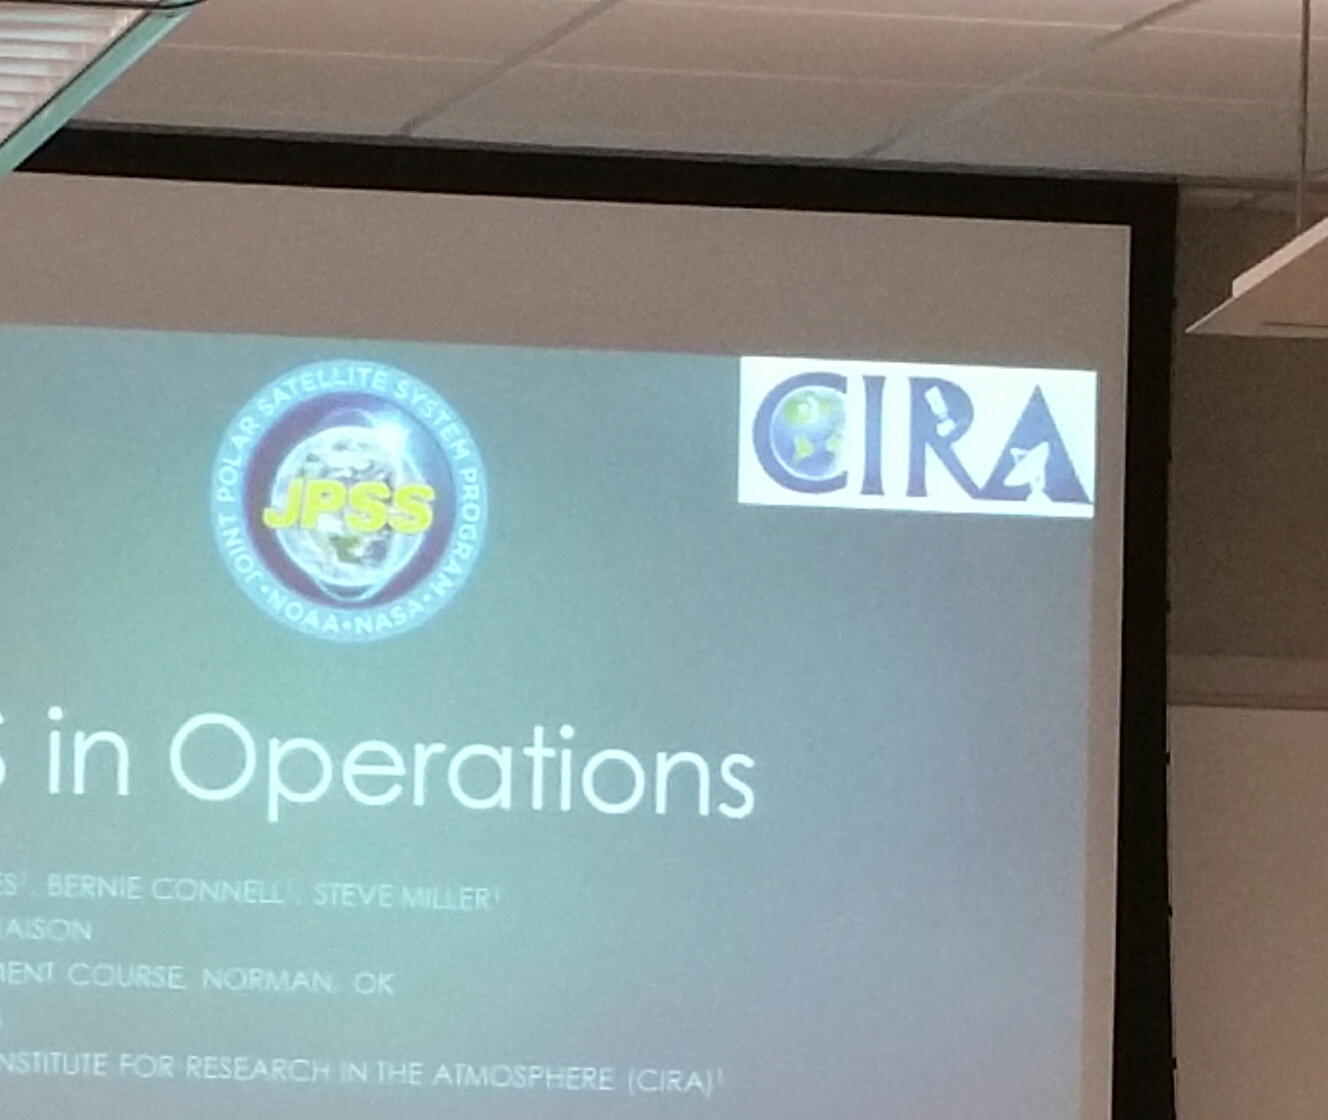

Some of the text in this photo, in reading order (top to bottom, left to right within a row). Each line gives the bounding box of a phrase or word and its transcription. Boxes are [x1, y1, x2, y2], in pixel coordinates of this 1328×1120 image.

[256, 366, 390, 417] SATELLITE
[394, 379, 470, 462] SYSTEM
[752, 371, 1094, 506] CIRA
[218, 414, 263, 501] POLAR
[263, 478, 435, 533] JPSS
[428, 466, 482, 598] PROGRAM
[265, 588, 424, 634] NOAA NASA
[47, 705, 130, 796] in
[170, 712, 756, 823] Operations
[46, 874, 142, 900] BERNIE
[314, 882, 393, 908] STEVE
[354, 973, 395, 995] OK
[119, 1054, 175, 1078] FOR
[186, 1055, 330, 1082] RESEARCH
[341, 1062, 369, 1084] IN
[377, 1061, 424, 1085] THE
[431, 1062, 615, 1092] ATMOSPHERE
